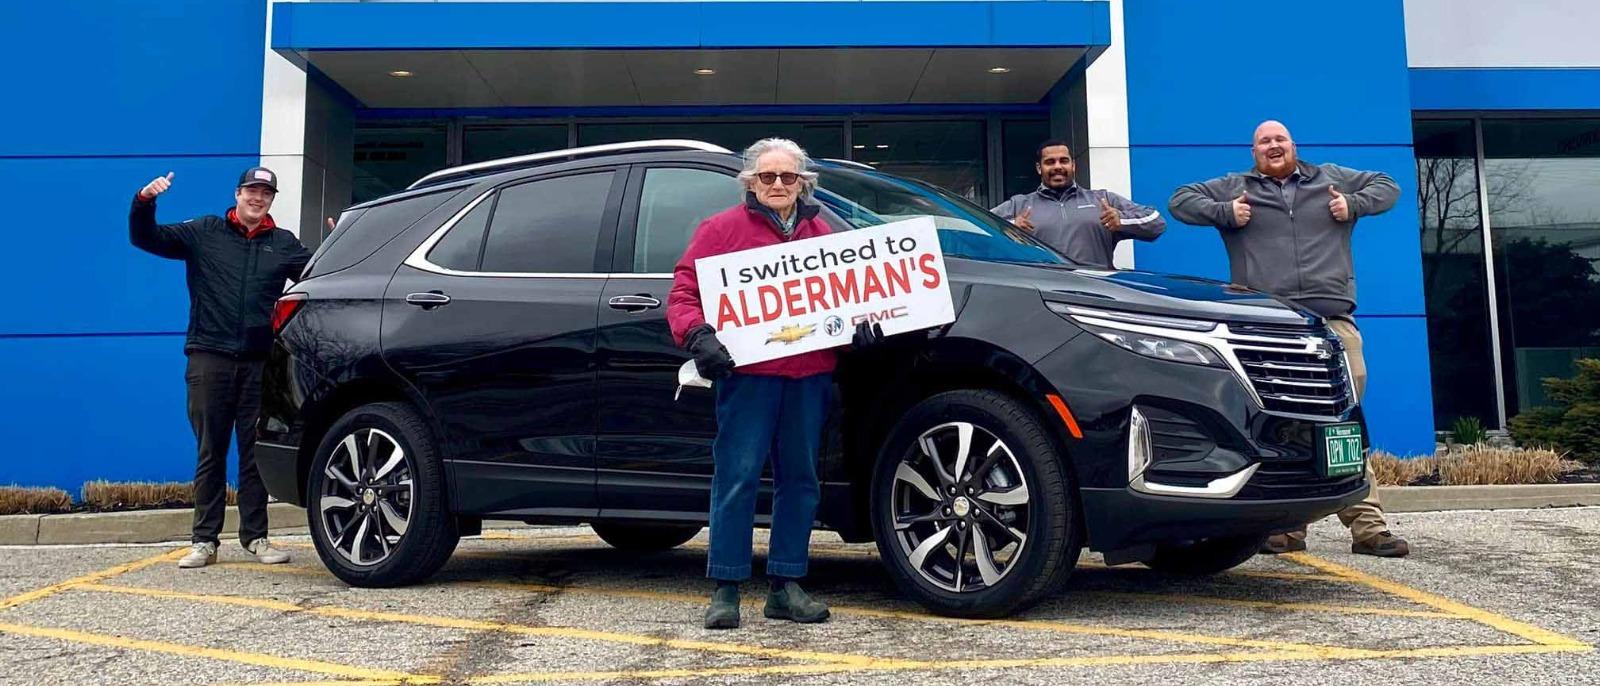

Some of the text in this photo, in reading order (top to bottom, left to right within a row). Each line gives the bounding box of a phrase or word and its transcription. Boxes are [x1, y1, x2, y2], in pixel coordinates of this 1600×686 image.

[720, 236, 917, 287] I switched to
[716, 253, 940, 331] ALDERMAN'S
[851, 306, 909, 326] GMC
[1346, 438, 1361, 461] 702
